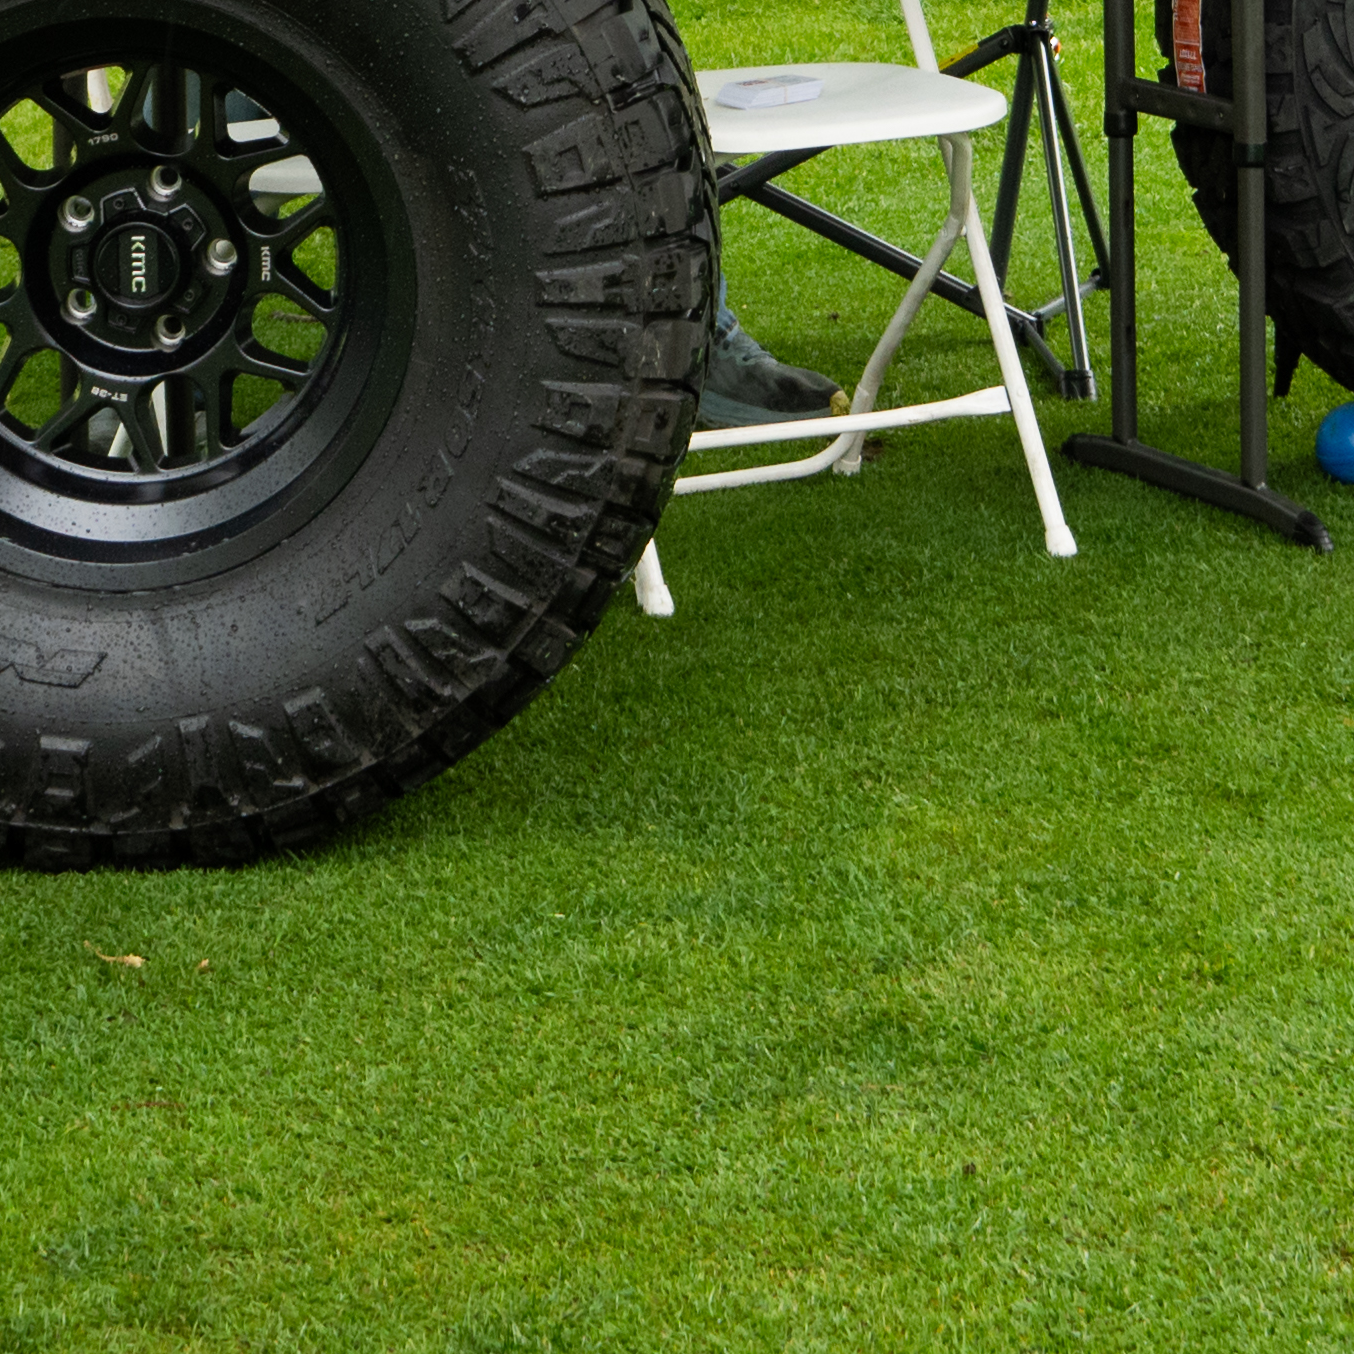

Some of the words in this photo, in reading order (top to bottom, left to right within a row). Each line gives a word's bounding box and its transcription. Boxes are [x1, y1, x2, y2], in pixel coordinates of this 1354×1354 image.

[88, 133, 119, 146] 1790
[129, 235, 147, 293] KMC
[260, 245, 272, 282] KMC
